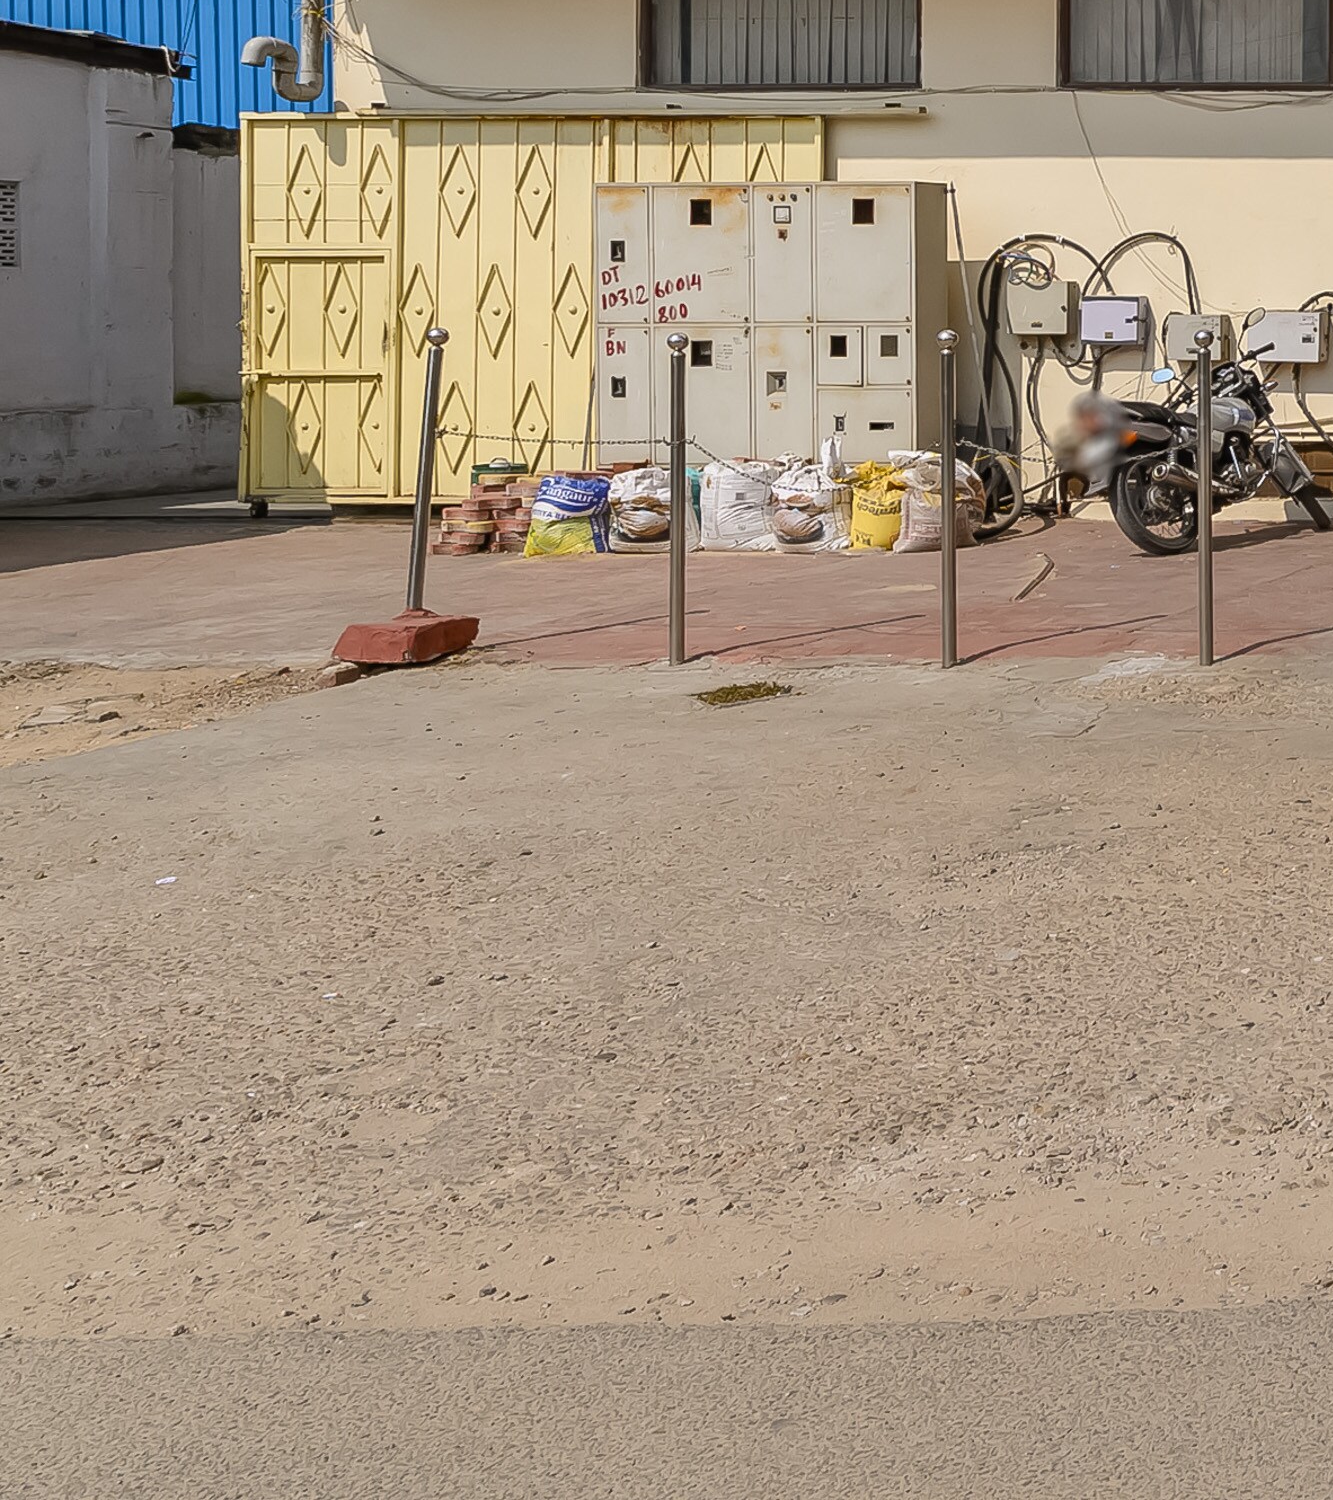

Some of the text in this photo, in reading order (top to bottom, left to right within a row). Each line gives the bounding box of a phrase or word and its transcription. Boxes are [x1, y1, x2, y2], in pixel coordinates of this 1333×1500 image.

[601, 265, 620, 286] DT
[601, 284, 650, 310] 10312
[658, 303, 688, 323] 800
[605, 340, 627, 356] BN
